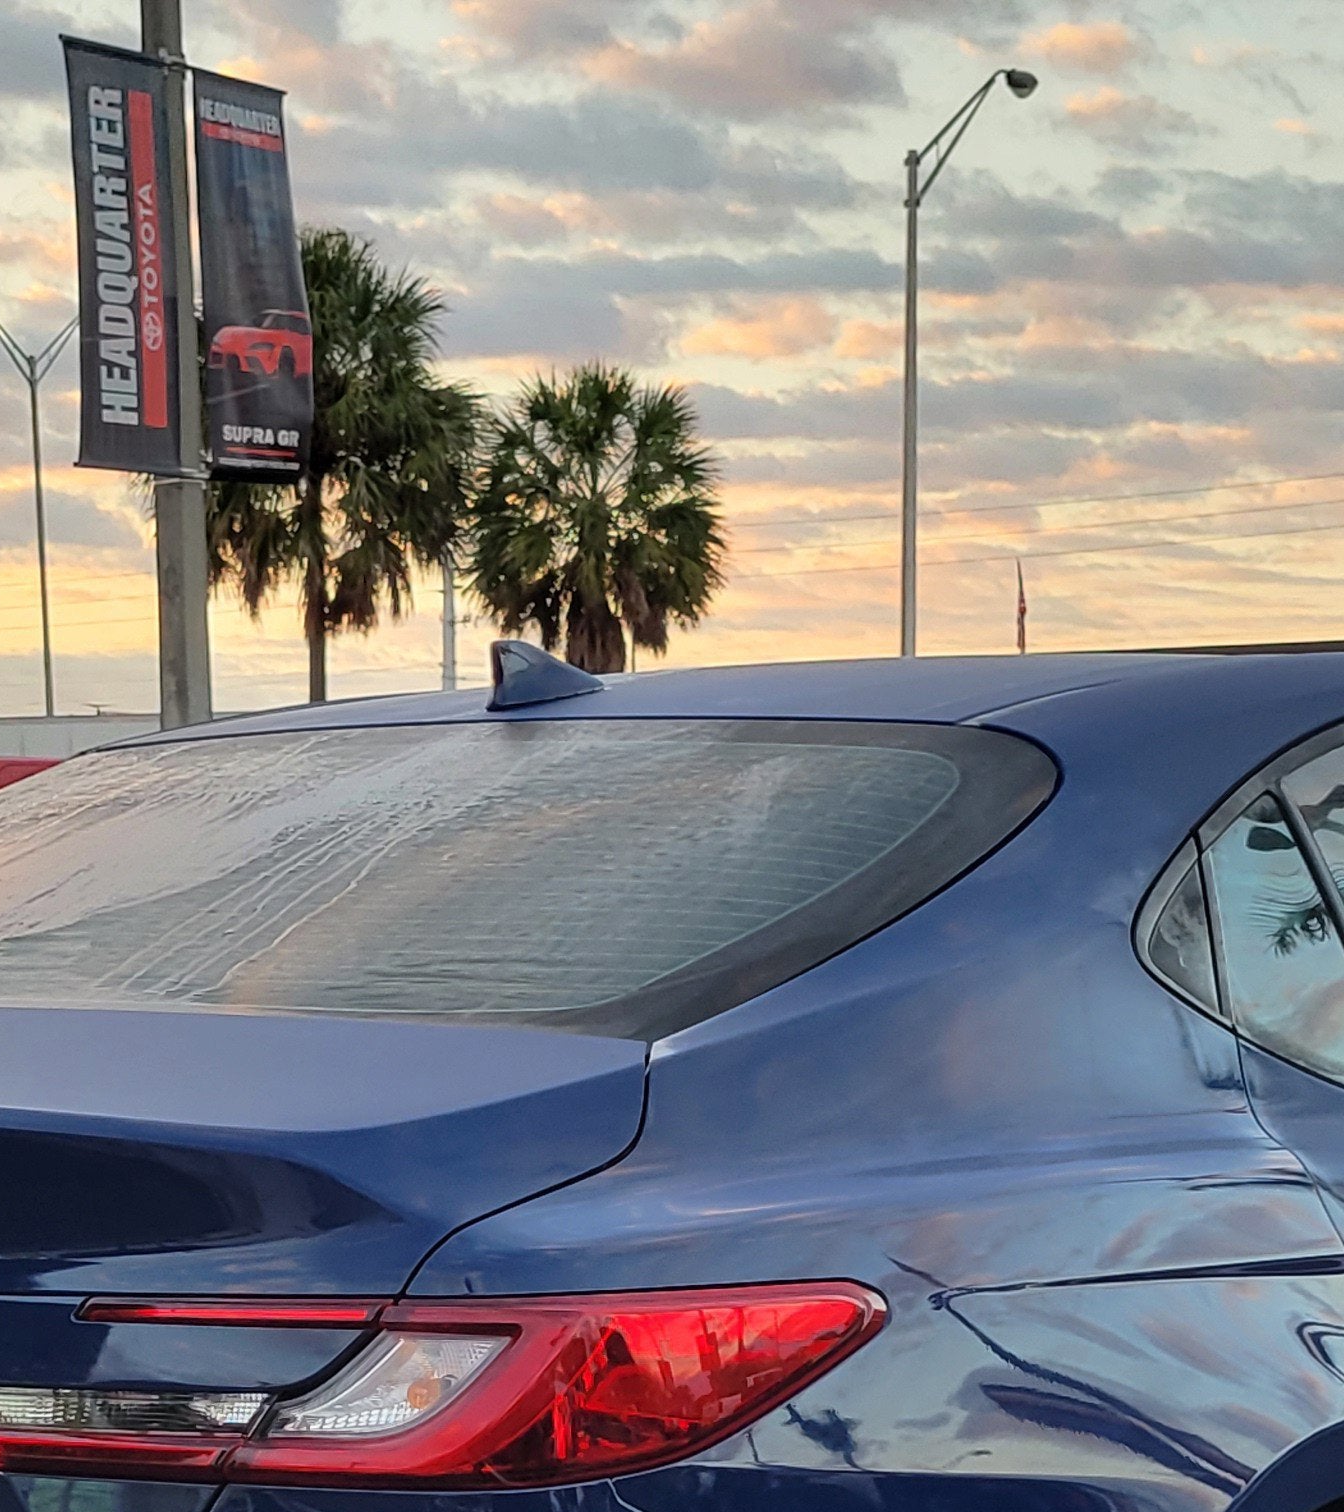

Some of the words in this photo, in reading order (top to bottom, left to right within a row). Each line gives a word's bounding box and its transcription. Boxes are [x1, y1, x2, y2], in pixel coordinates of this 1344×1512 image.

[87, 84, 140, 427] HEADQUARTER
[137, 182, 160, 306] TOYOTA
[221, 424, 275, 446] SUPRA
[277, 429, 301, 448] GR
